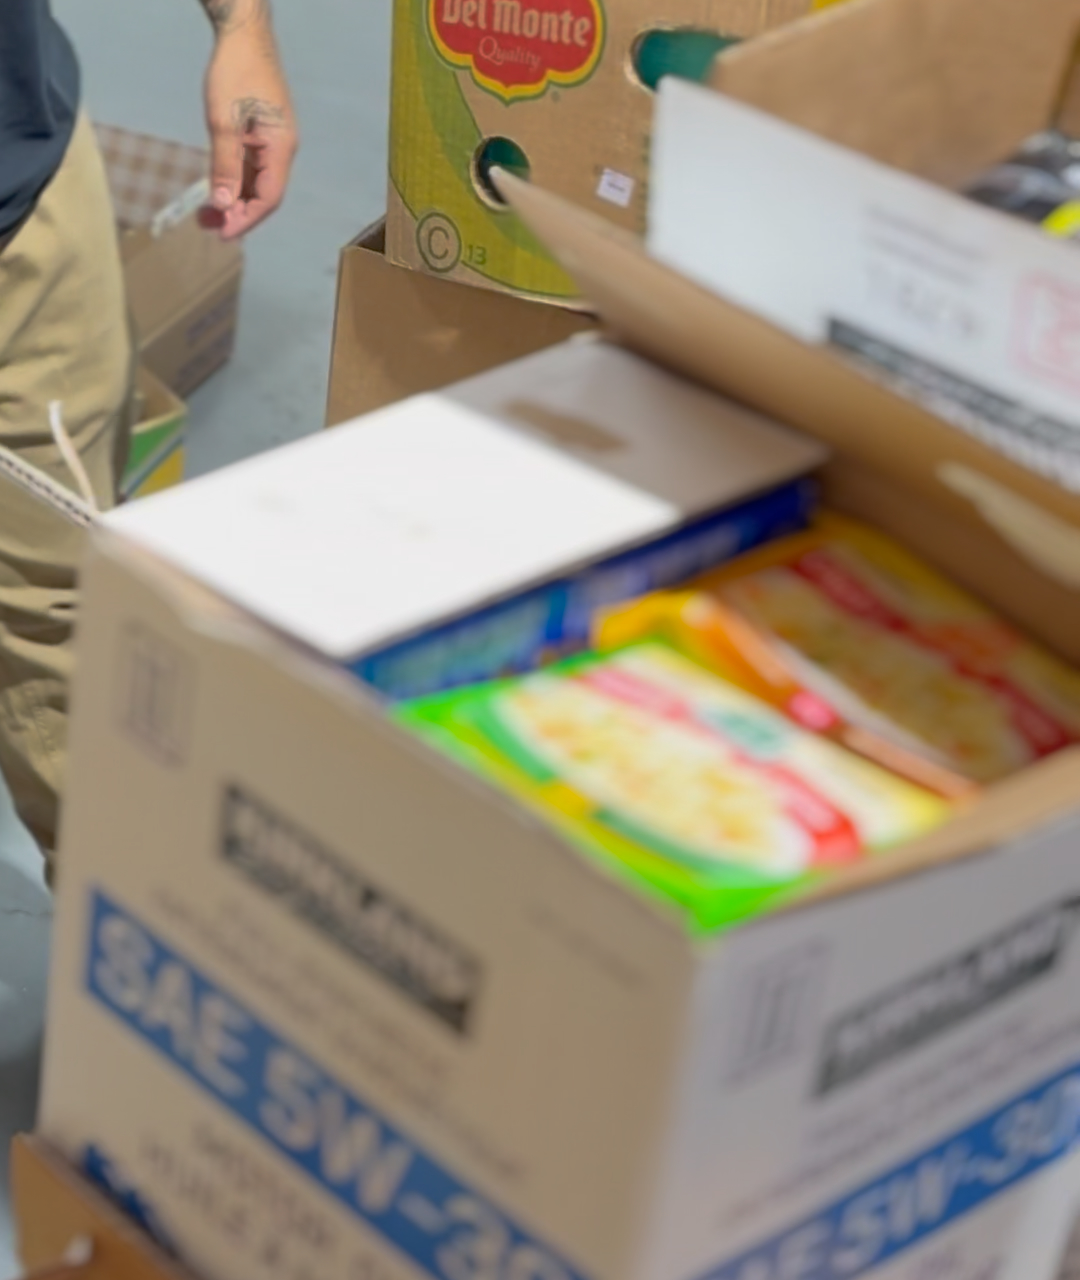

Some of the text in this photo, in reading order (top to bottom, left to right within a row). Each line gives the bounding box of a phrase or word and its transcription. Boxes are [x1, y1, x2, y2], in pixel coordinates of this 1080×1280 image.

[478, 35, 541, 72] Quality
[468, 243, 488, 266] 13
[92, 915, 251, 1099] SAE
